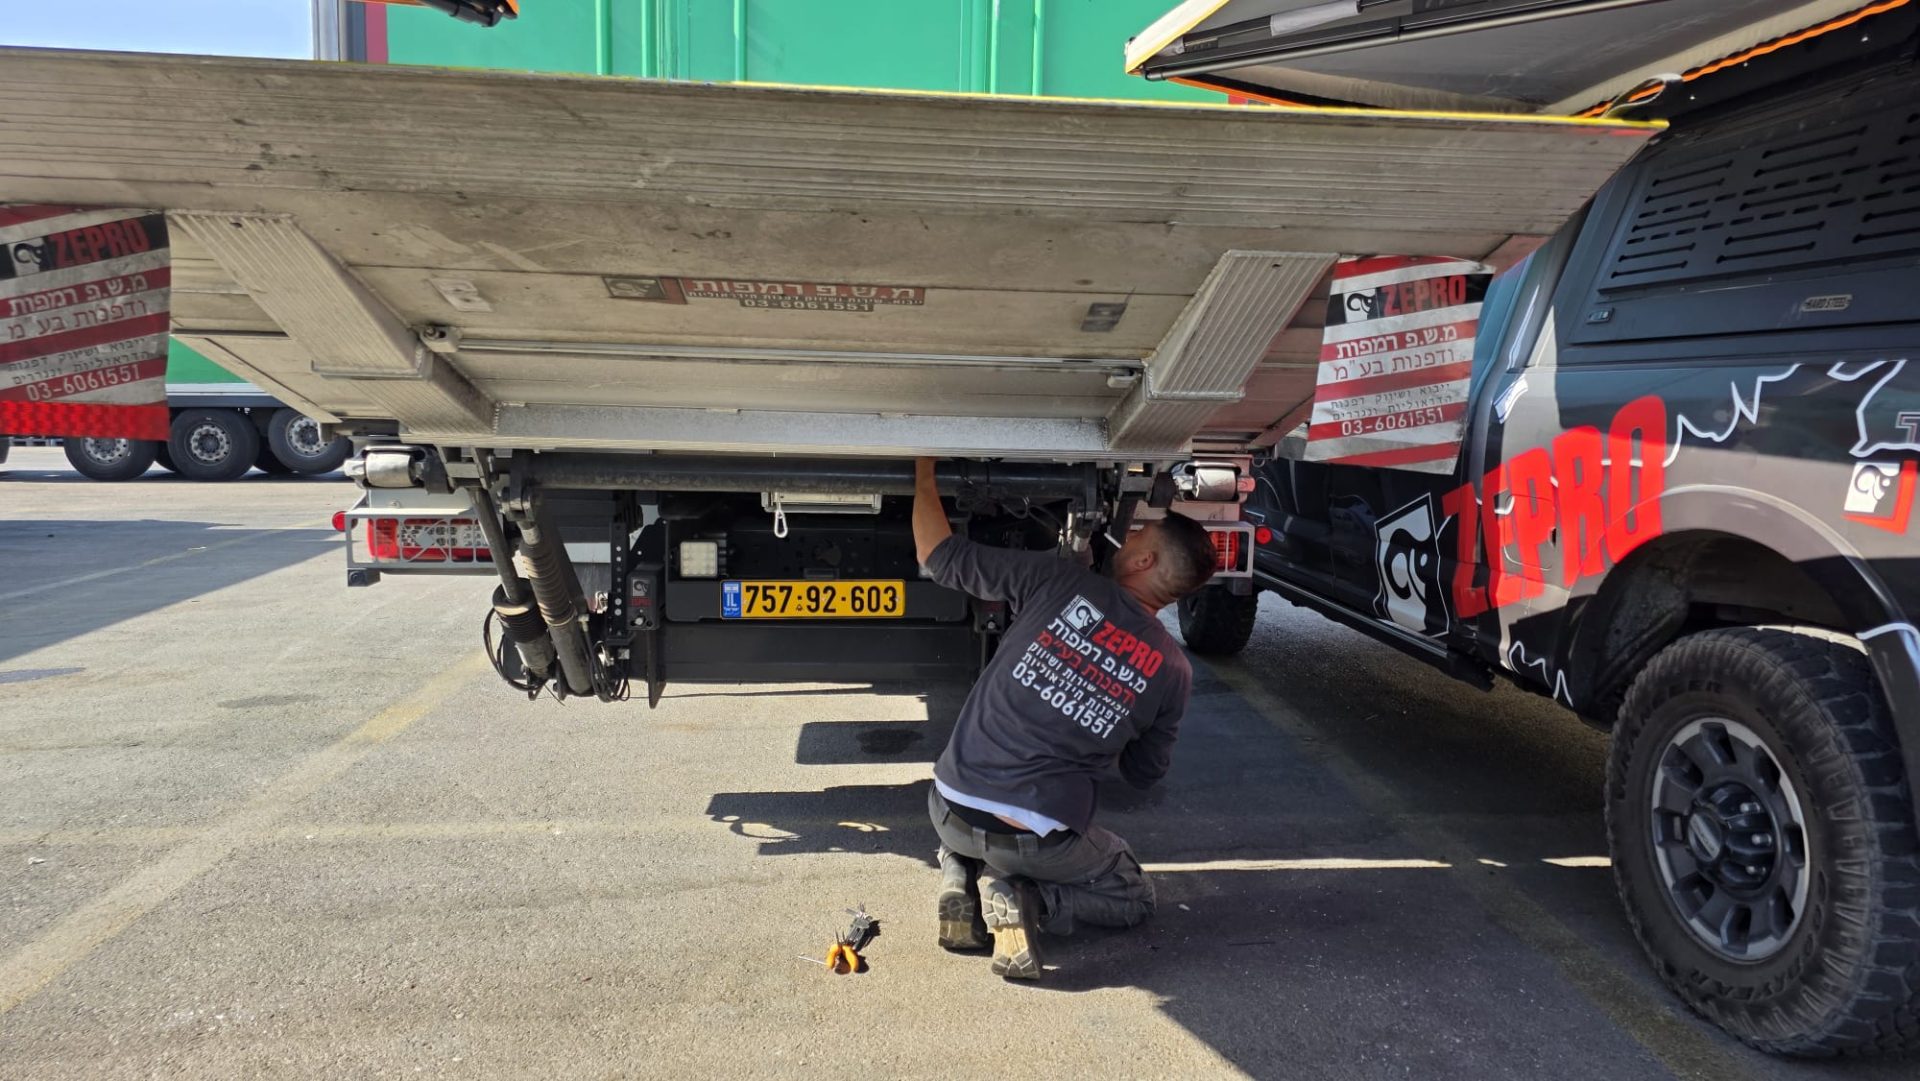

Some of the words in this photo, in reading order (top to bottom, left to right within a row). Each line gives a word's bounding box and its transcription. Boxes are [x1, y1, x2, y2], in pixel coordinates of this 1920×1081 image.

[50, 219, 149, 269] ZEPRO
[84, 274, 148, 299] מ.ש.פ
[692, 280, 804, 296] רמפות
[816, 285, 915, 299] מ.ש.פ
[1381, 275, 1467, 317] ZEPRO
[9, 287, 79, 317] רמפות
[74, 300, 148, 328] ודפנות
[744, 299, 870, 312] 03-6061551
[1336, 335, 1399, 359] רמפות
[1405, 325, 1457, 348] מ.ש.פ
[1392, 348, 1455, 373] ודפנות
[26, 364, 141, 401] 03-6061551
[1341, 407, 1444, 436] 03-6061551
[1442, 395, 1667, 619] ZEPRO
[1047, 617, 1103, 662] רמפות
[1091, 620, 1165, 679] ZEPRO
[1026, 642, 1062, 672] ושיווק
[1021, 652, 1085, 701] הידראוליות
[1062, 666, 1097, 693] שירות
[1101, 655, 1148, 694] מ.ש.פ
[1012, 661, 1115, 739] 03-6061551
[1085, 695, 1121, 724] דפנות
